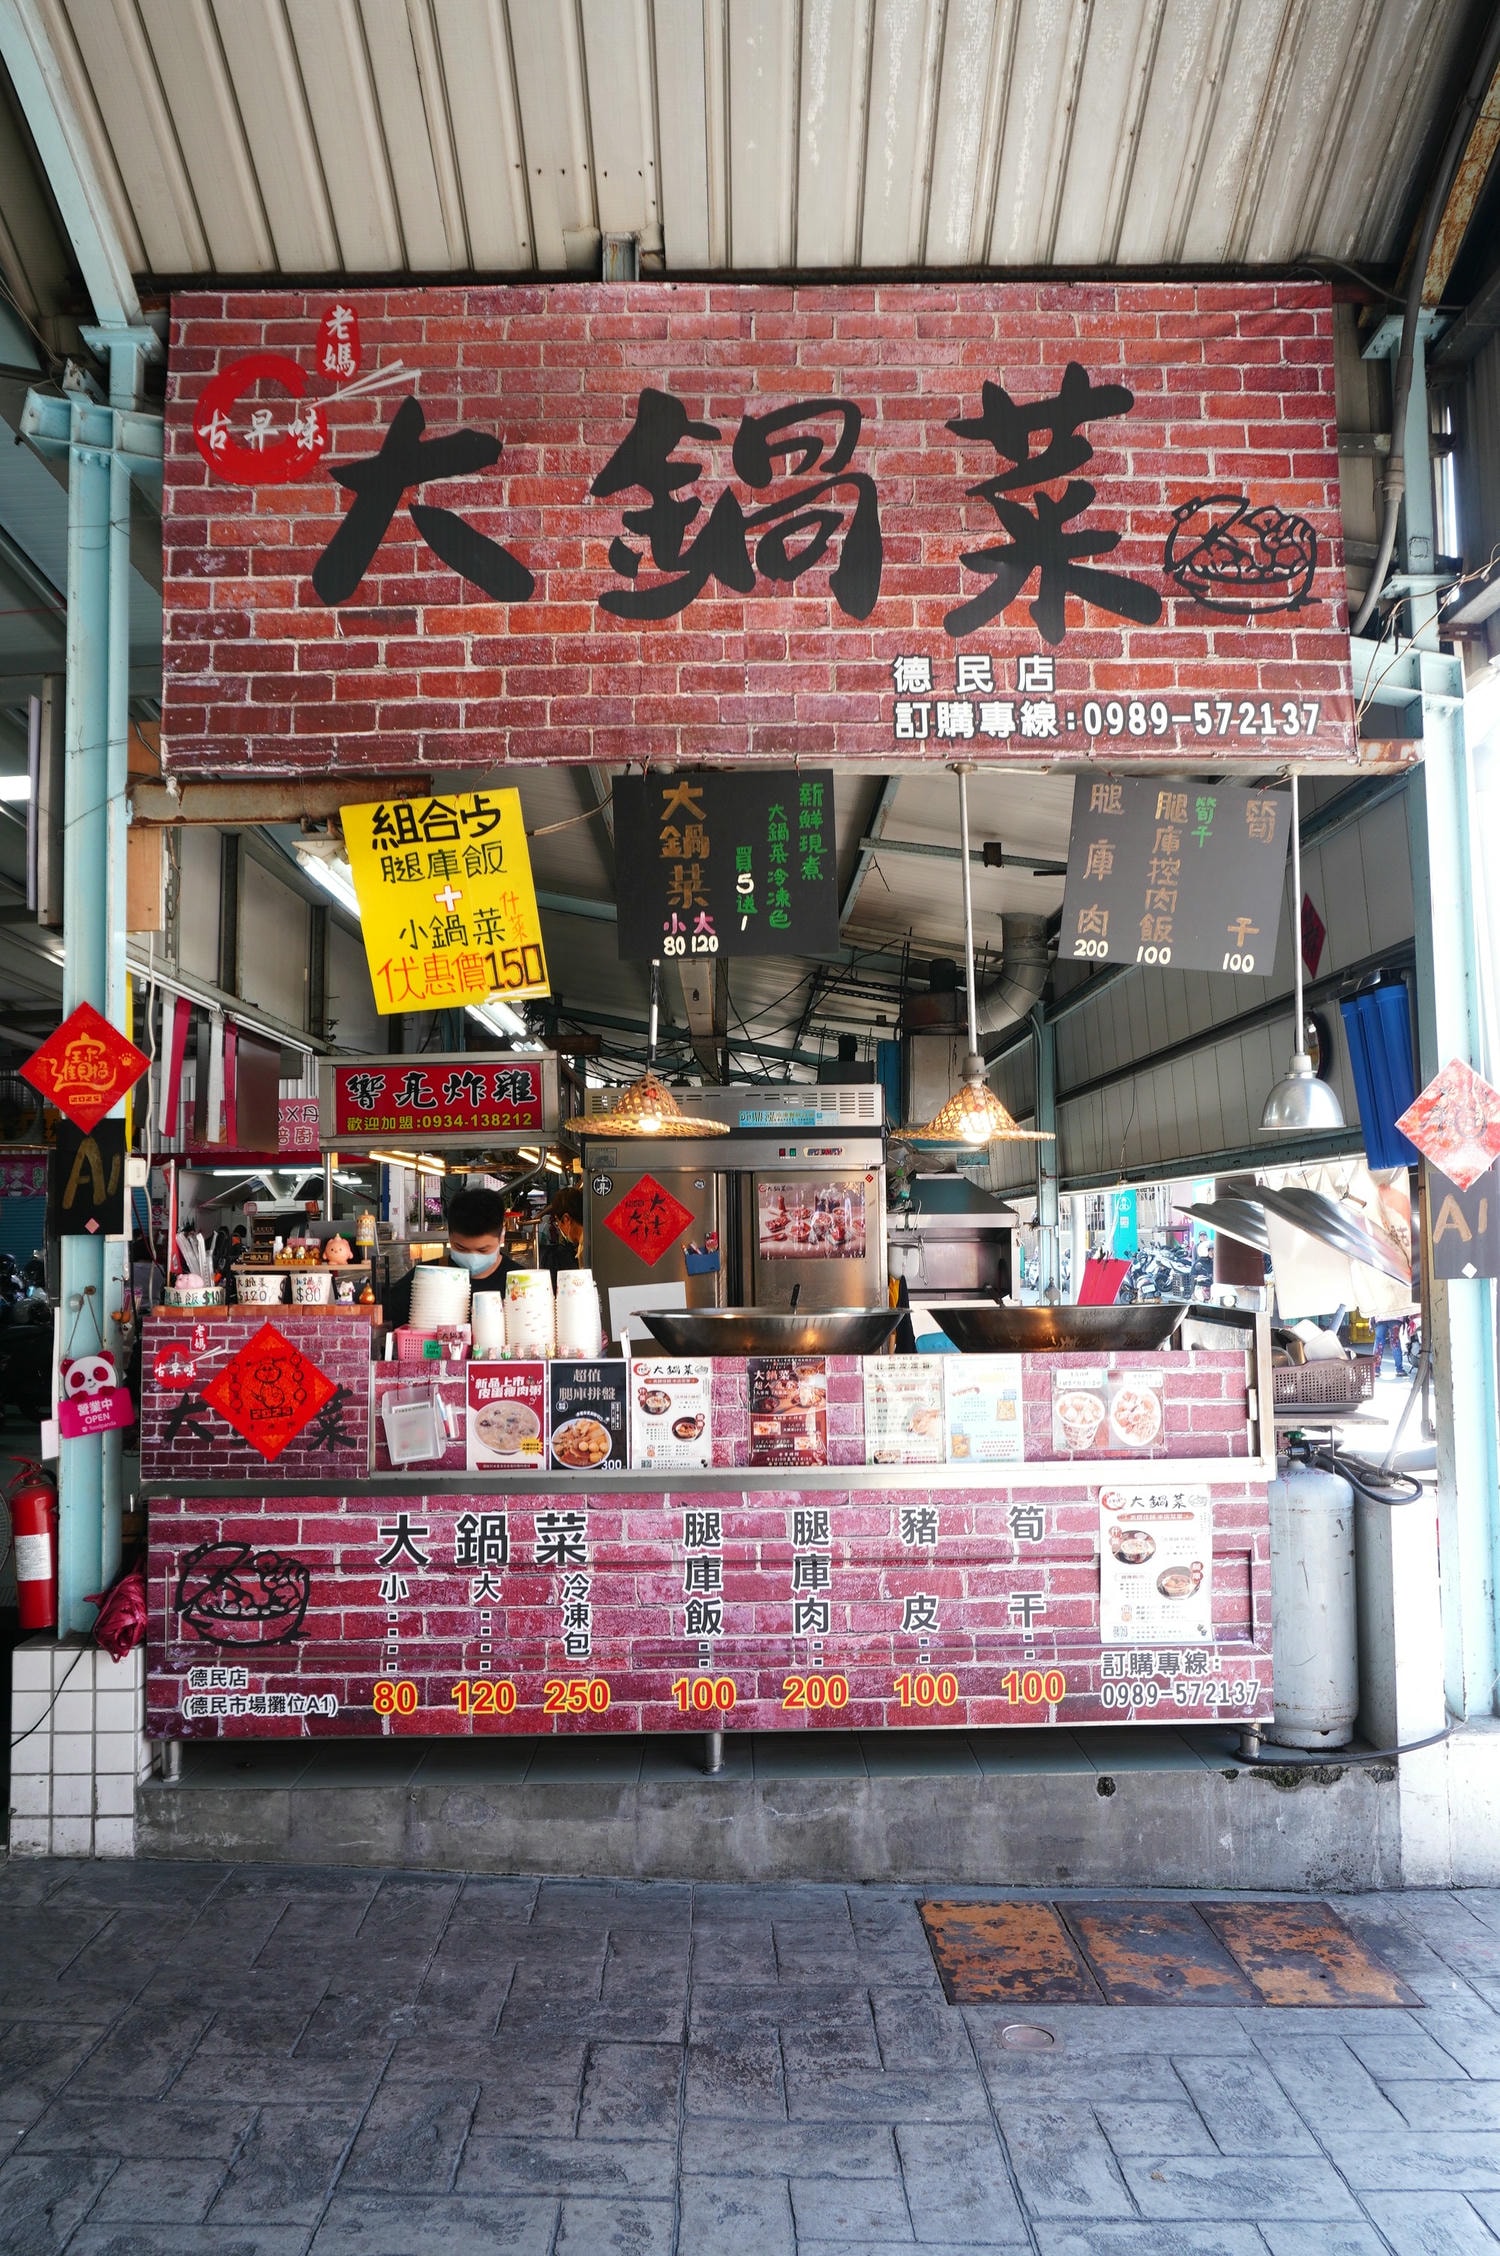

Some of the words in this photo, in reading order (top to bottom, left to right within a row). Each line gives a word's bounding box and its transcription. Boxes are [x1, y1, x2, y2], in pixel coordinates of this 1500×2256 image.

[321, 303, 355, 378] 老媽
[198, 409, 325, 452] 古早味
[312, 361, 1163, 646] 大鍋菜
[892, 655, 1056, 694] 德民店
[893, 700, 1321, 741] 訂購專線:0989-572137
[659, 781, 711, 909] 大鍋菜
[798, 782, 828, 880] 新鮮現煮
[381, 841, 508, 884] 腿庫飯
[1077, 783, 1125, 937] 腿庫肉
[1139, 790, 1188, 943] 腿庫控肉飯
[735, 845, 757, 931] 買5送1
[399, 908, 506, 950] 小鍋菜
[663, 912, 686, 934] 小
[693, 911, 716, 934] 大
[663, 935, 686, 956] 80
[691, 935, 719, 953] 120
[1073, 939, 1109, 958] 200
[1136, 946, 1171, 964] 100
[1222, 953, 1255, 973] 100
[346, 1070, 537, 1109] 響亮炸雞
[347, 1112, 532, 1131] 歡迎加盟:0934-138212
[296, 1286, 321, 1302] $80
[195, 1325, 206, 1350] 老媽
[154, 1361, 197, 1378] 古早味
[475, 1375, 525, 1389] 新品上市
[573, 1368, 601, 1382] 超值
[77, 1397, 113, 1416] 營業中
[85, 1412, 110, 1424] OPEN
[1131, 1493, 1186, 1509] 大鍋菜
[378, 1514, 588, 1566] 大鍋菜
[684, 1513, 723, 1636] 腿庫飯
[793, 1511, 830, 1634] 腿庫肉
[901, 1507, 938, 1632] 豬皮
[1009, 1505, 1046, 1628] 筍干
[382, 1574, 407, 1600] 小
[474, 1573, 500, 1600] 大
[563, 1573, 590, 1658] 冷凍包
[190, 1669, 246, 1687] 德民店
[1103, 1652, 1219, 1676] 訂購專線:
[374, 1681, 417, 1714] 80
[452, 1681, 516, 1714] 120
[544, 1680, 610, 1713] 250
[673, 1678, 736, 1711] 100
[783, 1676, 849, 1709] 200
[895, 1674, 958, 1706] 100
[1003, 1671, 1066, 1704] 100
[1103, 1682, 1259, 1706] 0989-572137
[184, 1696, 337, 1716] (德民市場攤位A1)
